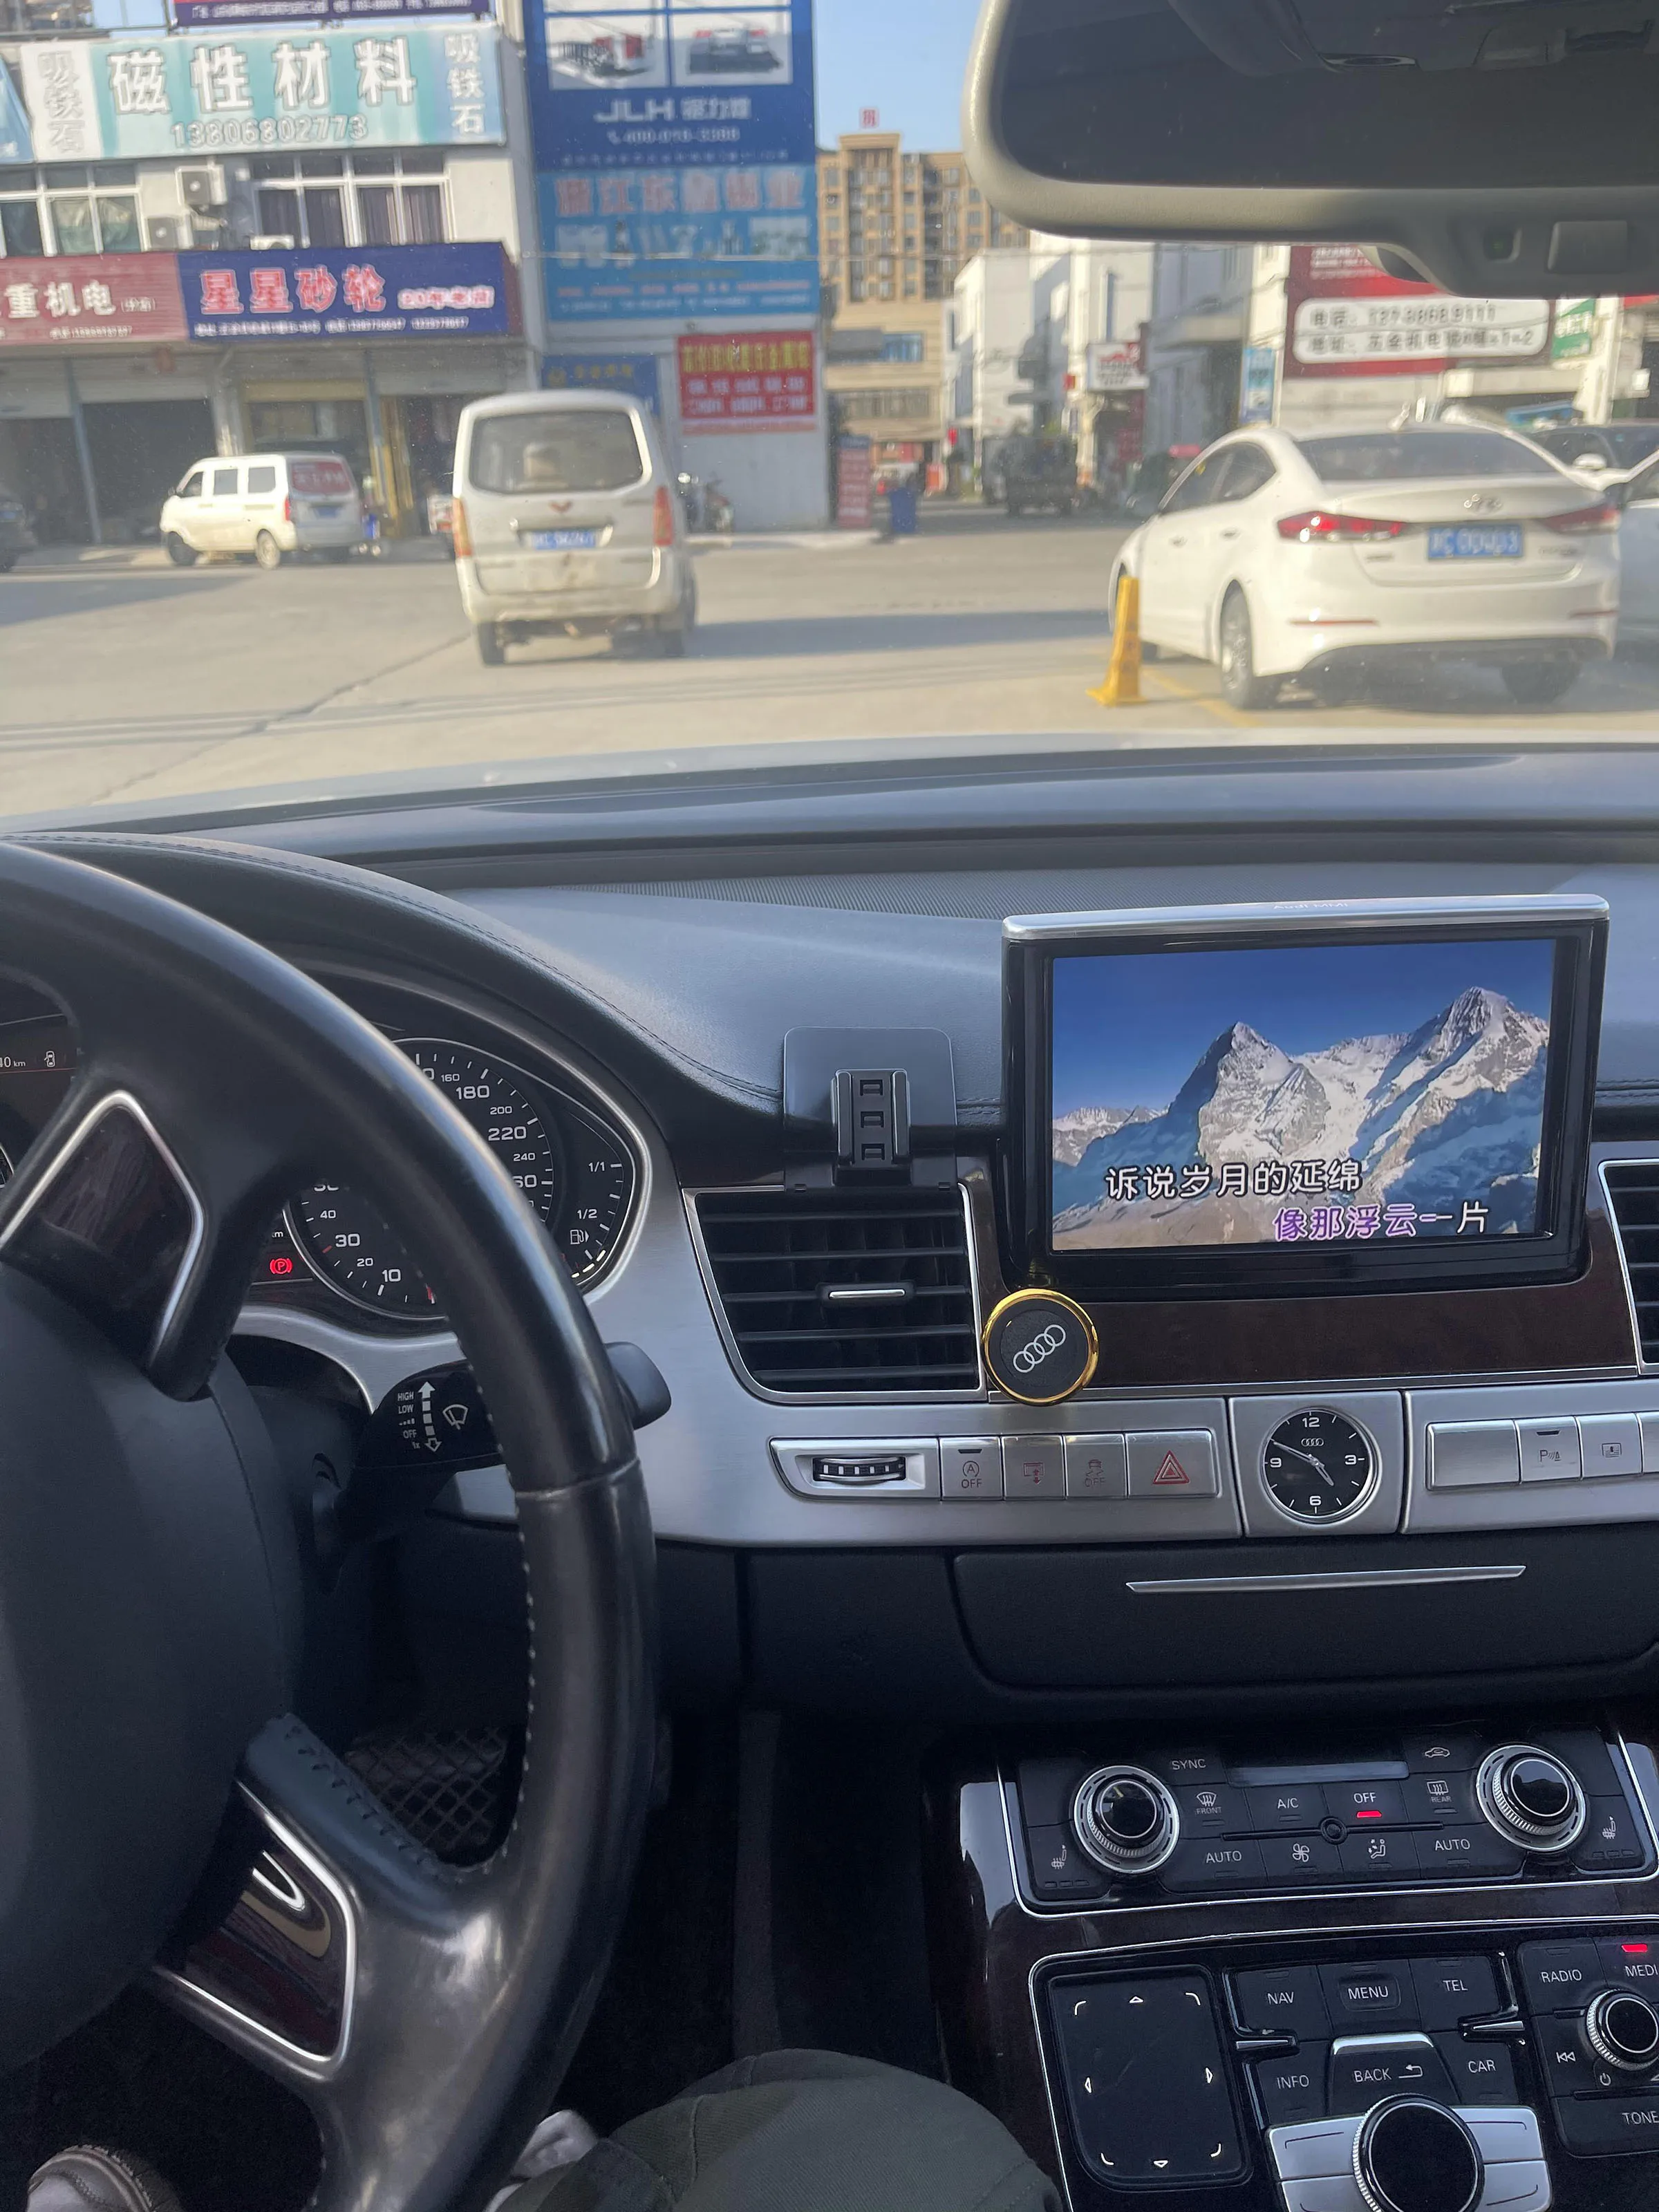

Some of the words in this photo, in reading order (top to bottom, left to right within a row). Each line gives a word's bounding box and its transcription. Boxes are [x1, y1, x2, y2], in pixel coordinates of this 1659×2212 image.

[106, 37, 416, 115] 磁性材料
[444, 33, 484, 135] 吸铁石
[170, 113, 368, 148] 13806802773
[200, 264, 386, 315] 星星砂轮
[440, 1074, 460, 1082] 160
[456, 1085, 490, 1100] 180
[489, 1106, 512, 1115] 200
[488, 1125, 527, 1141] 220
[513, 1152, 536, 1162] 240
[588, 1161, 606, 1172] 1/1
[512, 1174, 537, 1188] 60
[1105, 1160, 1362, 1199] 诉说岁月的延绵
[319, 1210, 337, 1219] 40
[577, 1208, 597, 1219] 1/2
[1273, 1202, 1489, 1241] 像那浮云一片
[335, 1233, 360, 1248] 30
[357, 1257, 373, 1267] 20
[382, 1268, 401, 1282] 10
[397, 1391, 414, 1401] HIGH
[398, 1405, 413, 1414] LOW
[1302, 1417, 1320, 1428] 12
[403, 1429, 417, 1439] OFF
[1271, 1457, 1282, 1468] 9
[1344, 1454, 1356, 1465] 3
[961, 1478, 982, 1488] OFF
[1085, 1477, 1106, 1487] OFF
[1309, 1495, 1321, 1507] 6
[1172, 1759, 1206, 1770] SYNC
[1353, 1792, 1376, 1803] OFF
[1431, 1794, 1452, 1803] REAR
[1277, 1798, 1299, 1809] A/C
[1196, 1806, 1222, 1815] FRONT
[1434, 1839, 1471, 1850] AUTO
[1206, 1850, 1242, 1864] AUTO
[1541, 1969, 1582, 1983] RADIO
[1443, 1980, 1468, 1991] TEL
[1267, 1991, 1295, 2005] NAV
[1347, 1986, 1389, 2000] MENU
[1468, 2059, 1496, 2073] CAR
[1353, 2068, 1389, 2083] BACK
[1276, 2075, 1309, 2089] INFO
[1622, 2111, 1659, 2126] TONE
